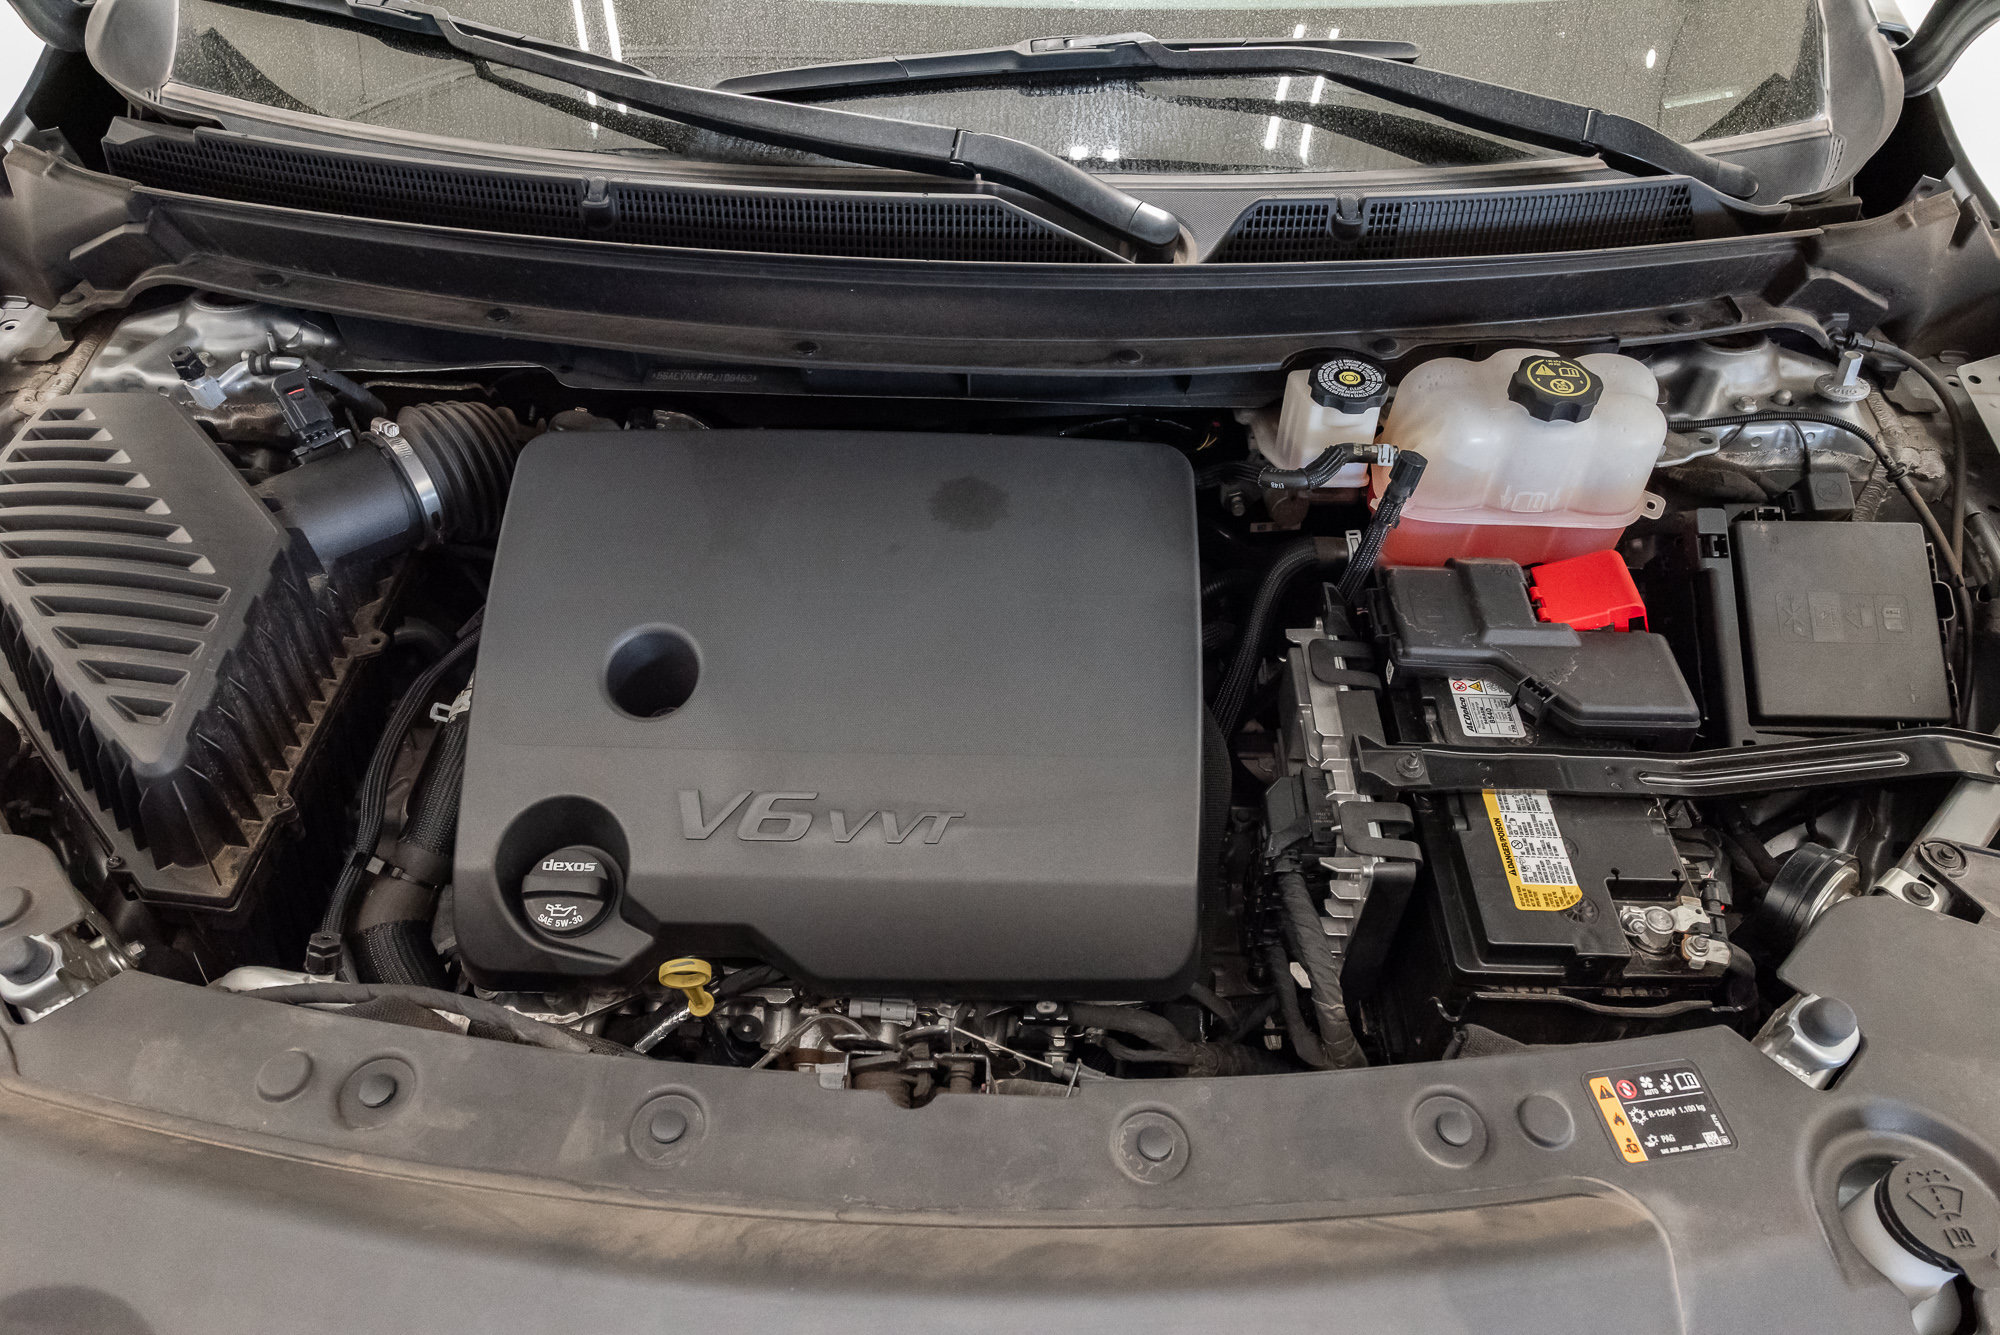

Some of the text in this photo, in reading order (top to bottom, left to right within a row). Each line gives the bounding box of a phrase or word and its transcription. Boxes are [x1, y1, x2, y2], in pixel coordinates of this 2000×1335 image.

[1460, 697, 1474, 732] ACDelco
[678, 789, 966, 844] V6 VVT
[542, 858, 598, 872] dexos
[537, 913, 583, 927] SAE 5W-30
[1644, 1088, 1659, 1096] AUTO
[1647, 1107, 1677, 1118] R-1234yf
[1696, 1104, 1707, 1112] kg
[1660, 1133, 1676, 1143] PAG
